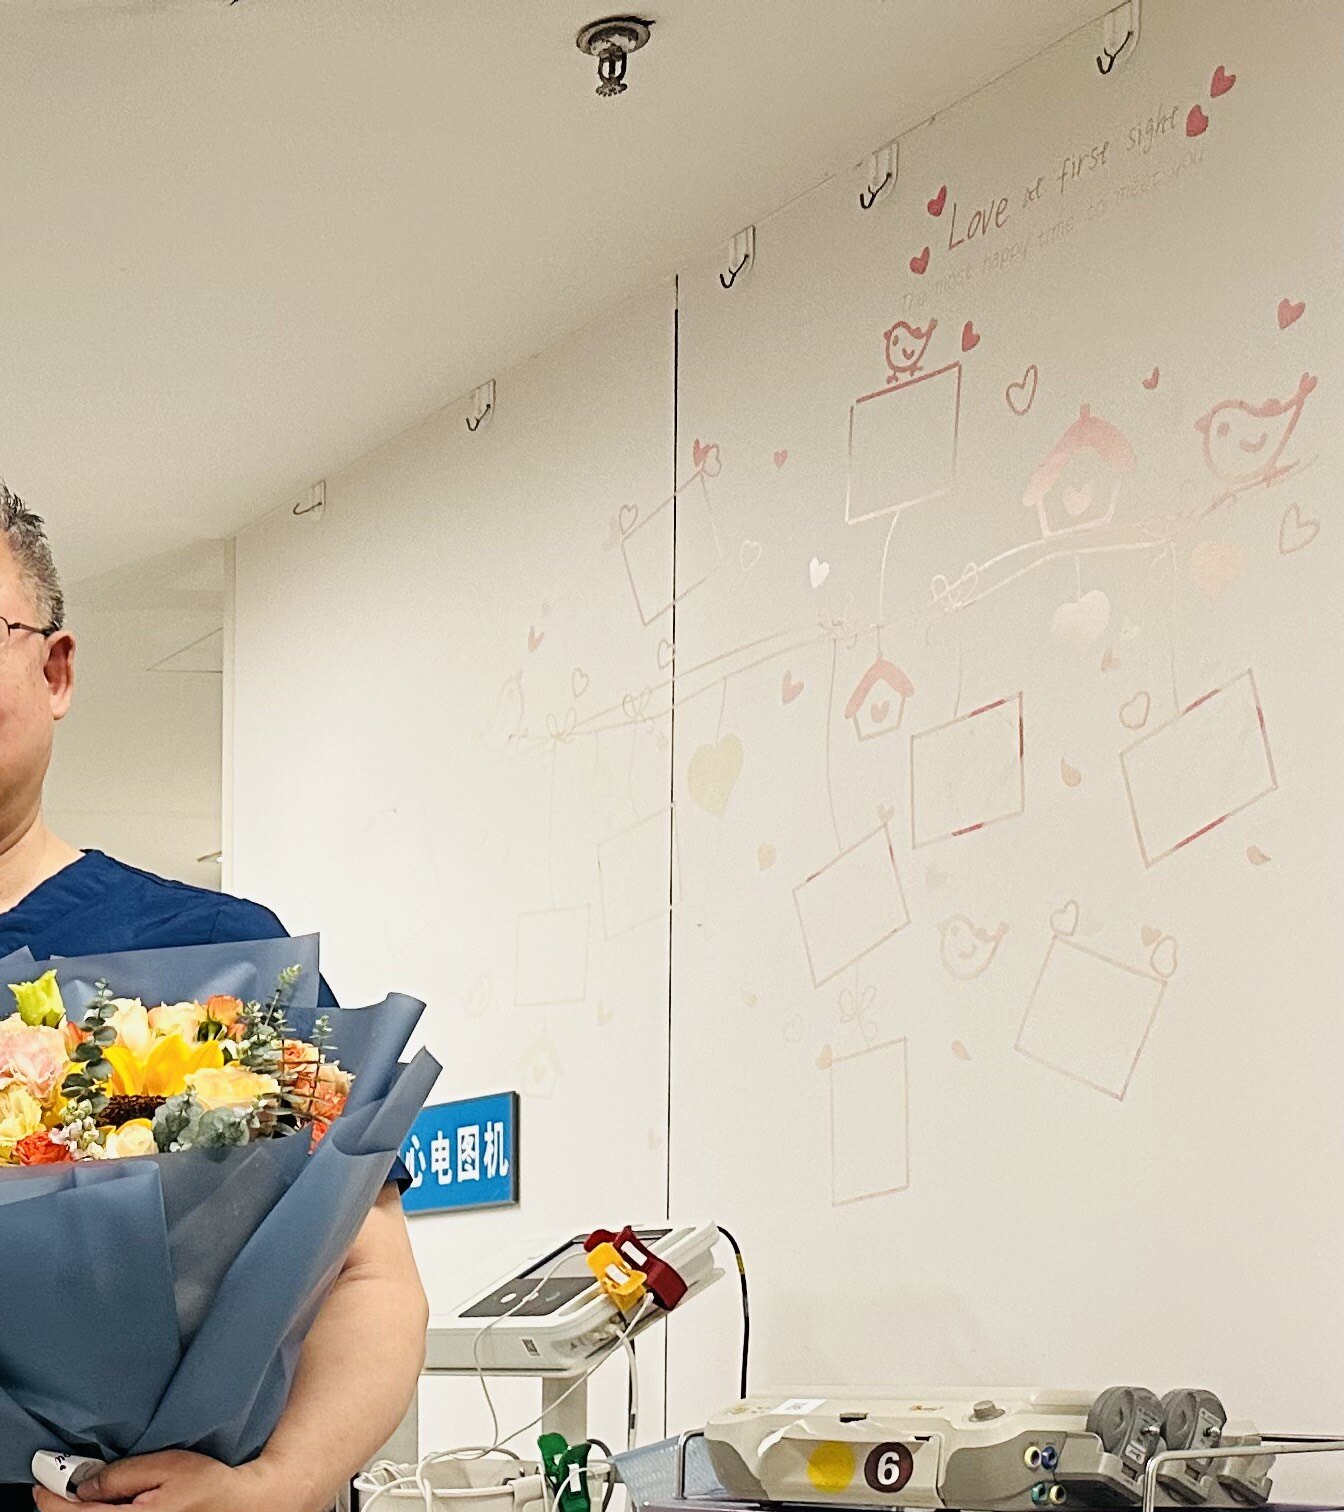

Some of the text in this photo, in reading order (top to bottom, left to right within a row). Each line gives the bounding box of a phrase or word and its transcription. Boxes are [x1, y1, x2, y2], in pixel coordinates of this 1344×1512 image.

[948, 197, 1009, 251] Love
[1056, 141, 1110, 194] first
[1125, 103, 1180, 155] sight
[404, 1120, 510, 1189] 心电图机
[876, 1451, 900, 1486] 6
